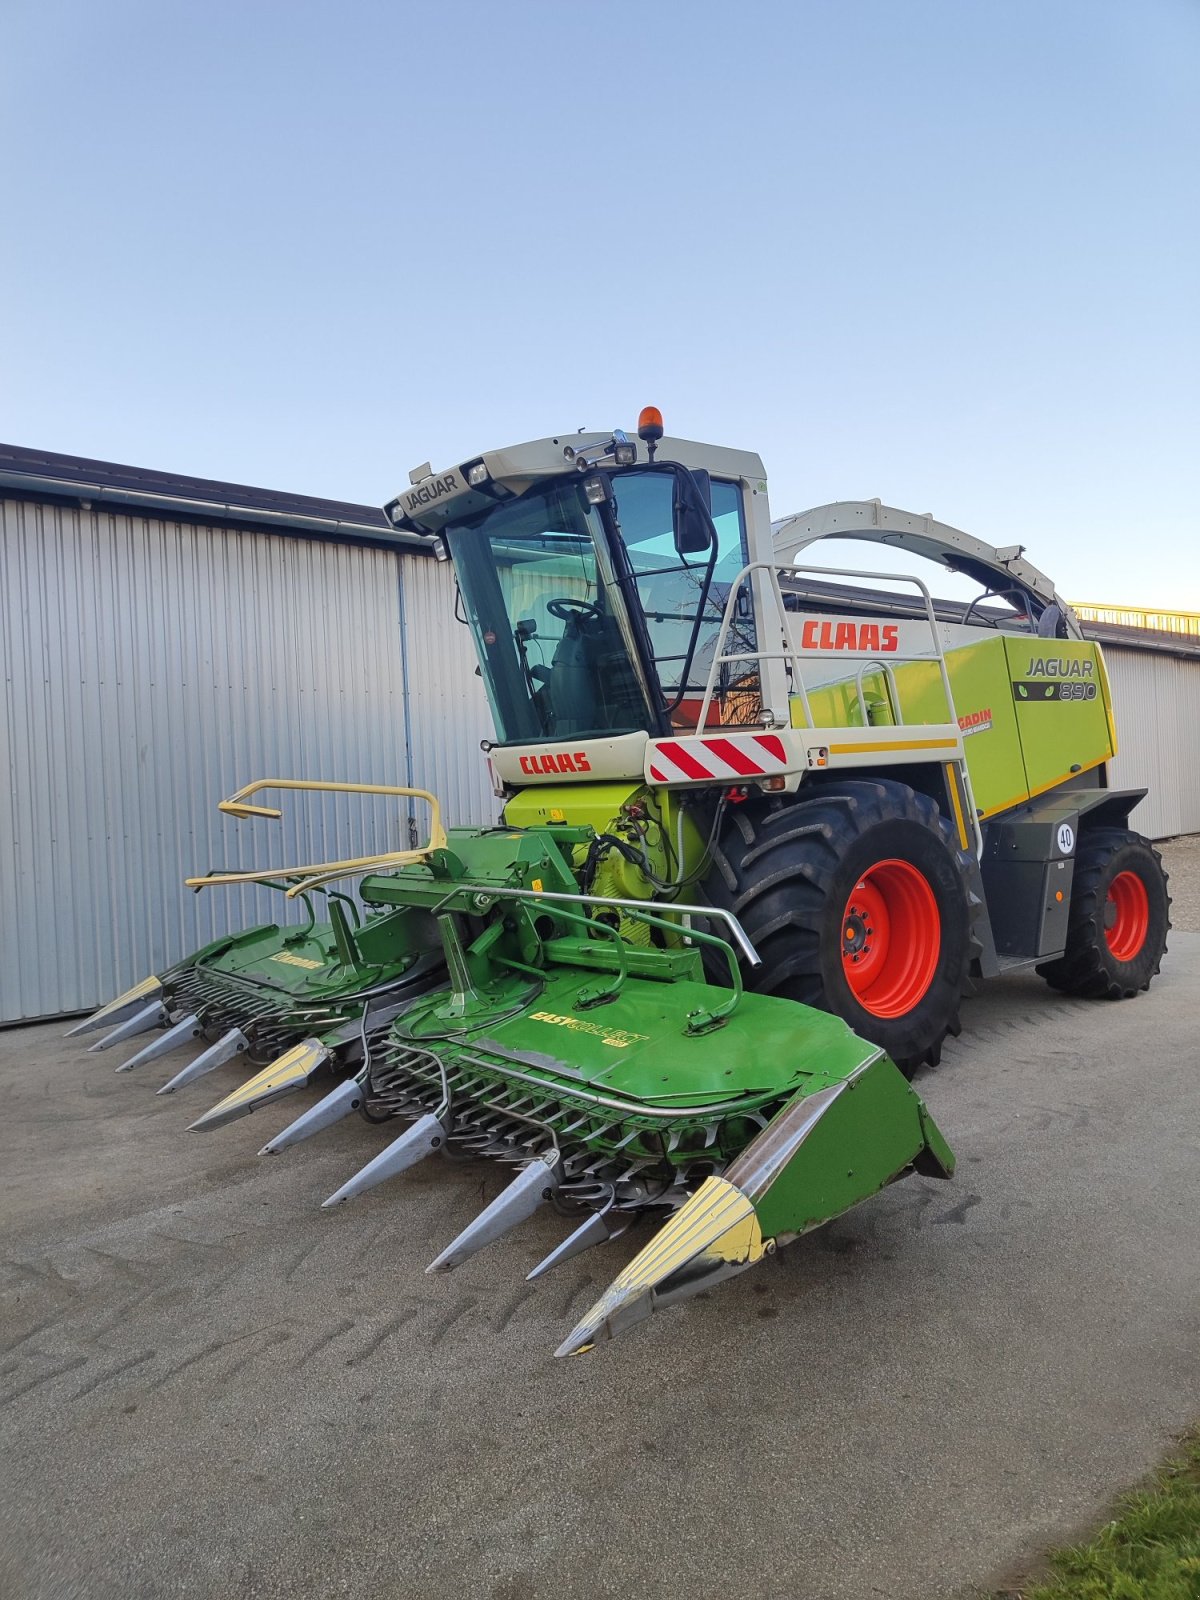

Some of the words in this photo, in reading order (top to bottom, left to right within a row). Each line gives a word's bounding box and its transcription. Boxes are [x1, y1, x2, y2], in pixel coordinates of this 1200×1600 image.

[406, 475, 458, 510] JAGUAR
[801, 621, 898, 652] CLAAS
[1026, 657, 1093, 678] JAGUAR
[1059, 682, 1097, 701] 890
[519, 752, 592, 775] CLAAS
[1060, 829, 1071, 848] 40
